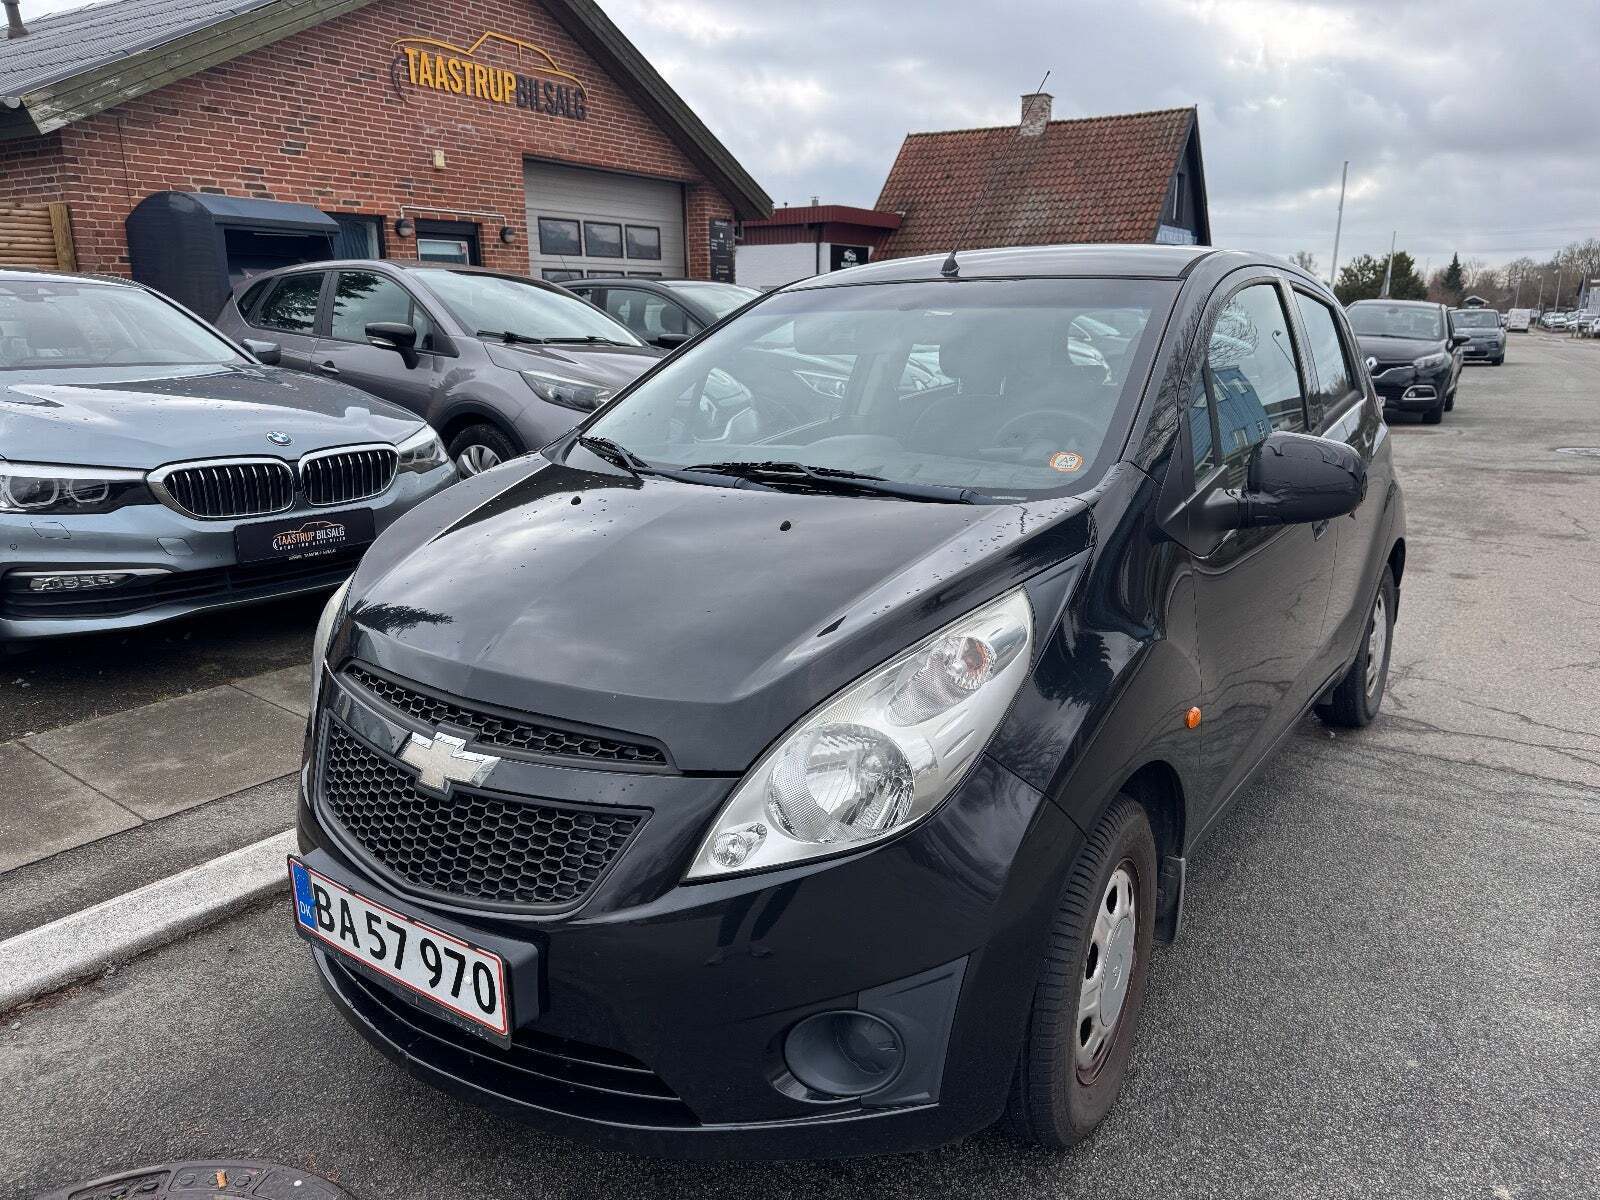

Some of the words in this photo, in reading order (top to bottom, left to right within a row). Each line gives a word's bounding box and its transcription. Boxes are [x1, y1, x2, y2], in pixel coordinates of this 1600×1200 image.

[277, 531, 315, 546] TAASTRUP
[316, 526, 345, 540] BILSALG
[299, 901, 313, 919] DK
[312, 882, 360, 949] BA
[365, 910, 407, 971] 57
[419, 937, 497, 1016] 970
